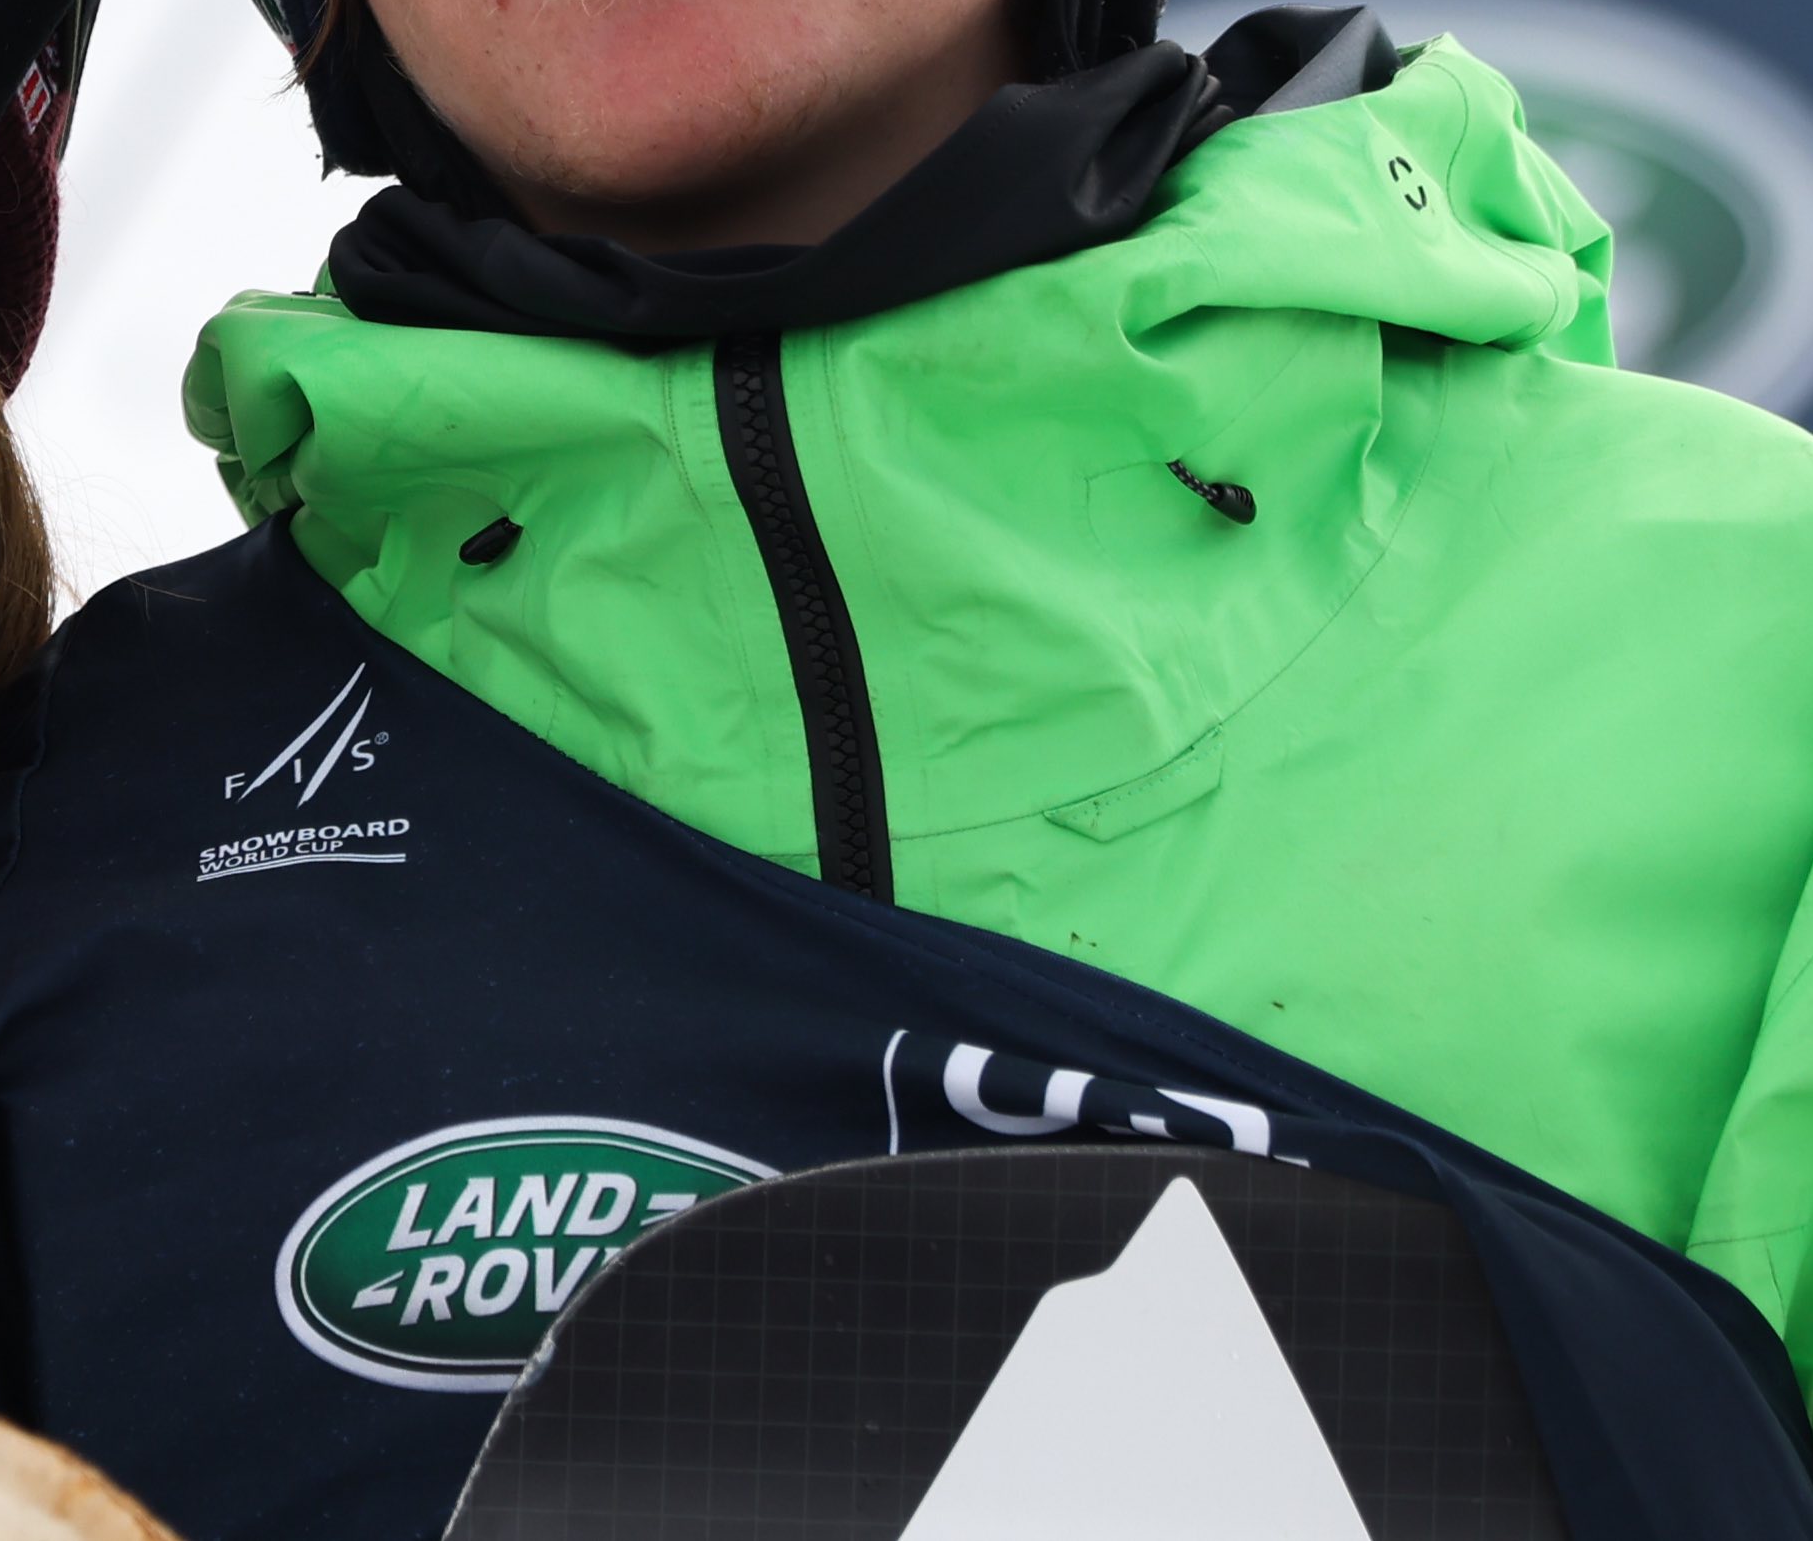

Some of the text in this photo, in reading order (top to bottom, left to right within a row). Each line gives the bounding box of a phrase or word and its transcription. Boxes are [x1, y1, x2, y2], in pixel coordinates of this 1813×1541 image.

[199, 818, 411, 864] SNOWBOARD
[199, 839, 344, 874] WORLD CUP
[386, 1172, 638, 1251] LAND
[399, 1246, 621, 1326] ROV
